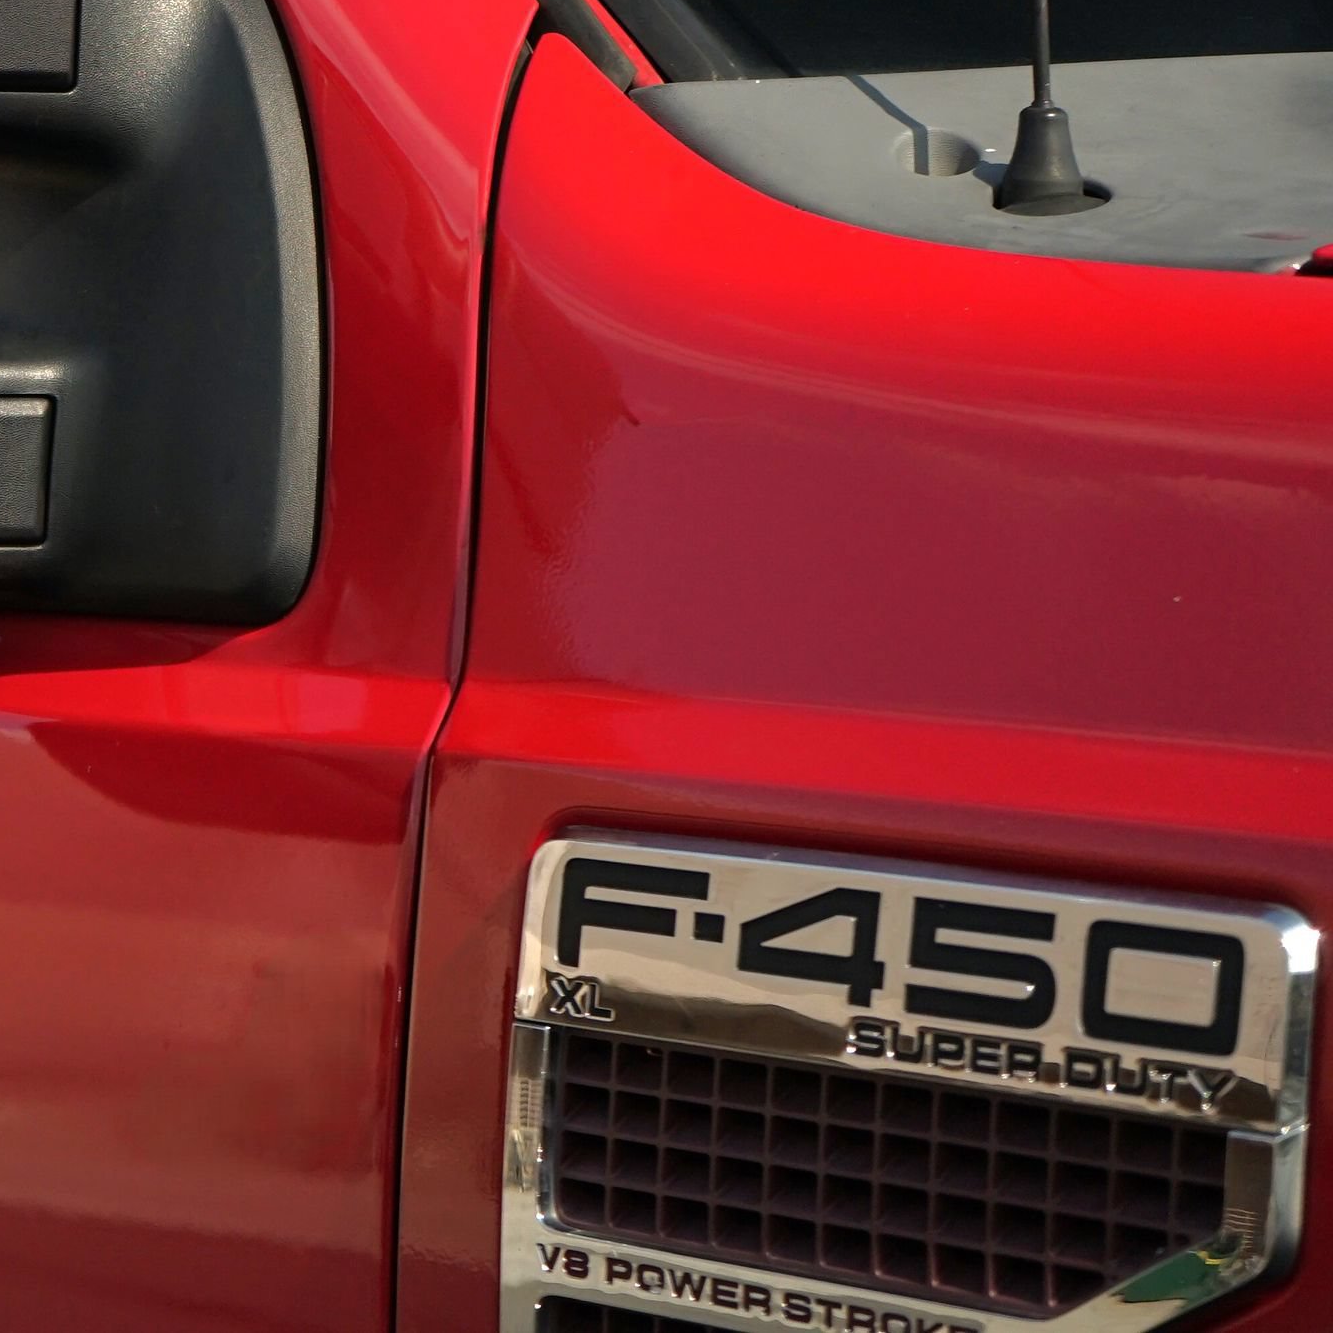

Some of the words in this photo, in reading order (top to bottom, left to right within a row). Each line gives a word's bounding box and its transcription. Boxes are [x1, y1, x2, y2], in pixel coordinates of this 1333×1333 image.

[550, 976, 616, 1022] XL
[846, 1016, 1043, 1083] SUPER
[1061, 1047, 1236, 1112] DUTY
[535, 1242, 590, 1279] V8
[603, 1256, 773, 1316] POWER
